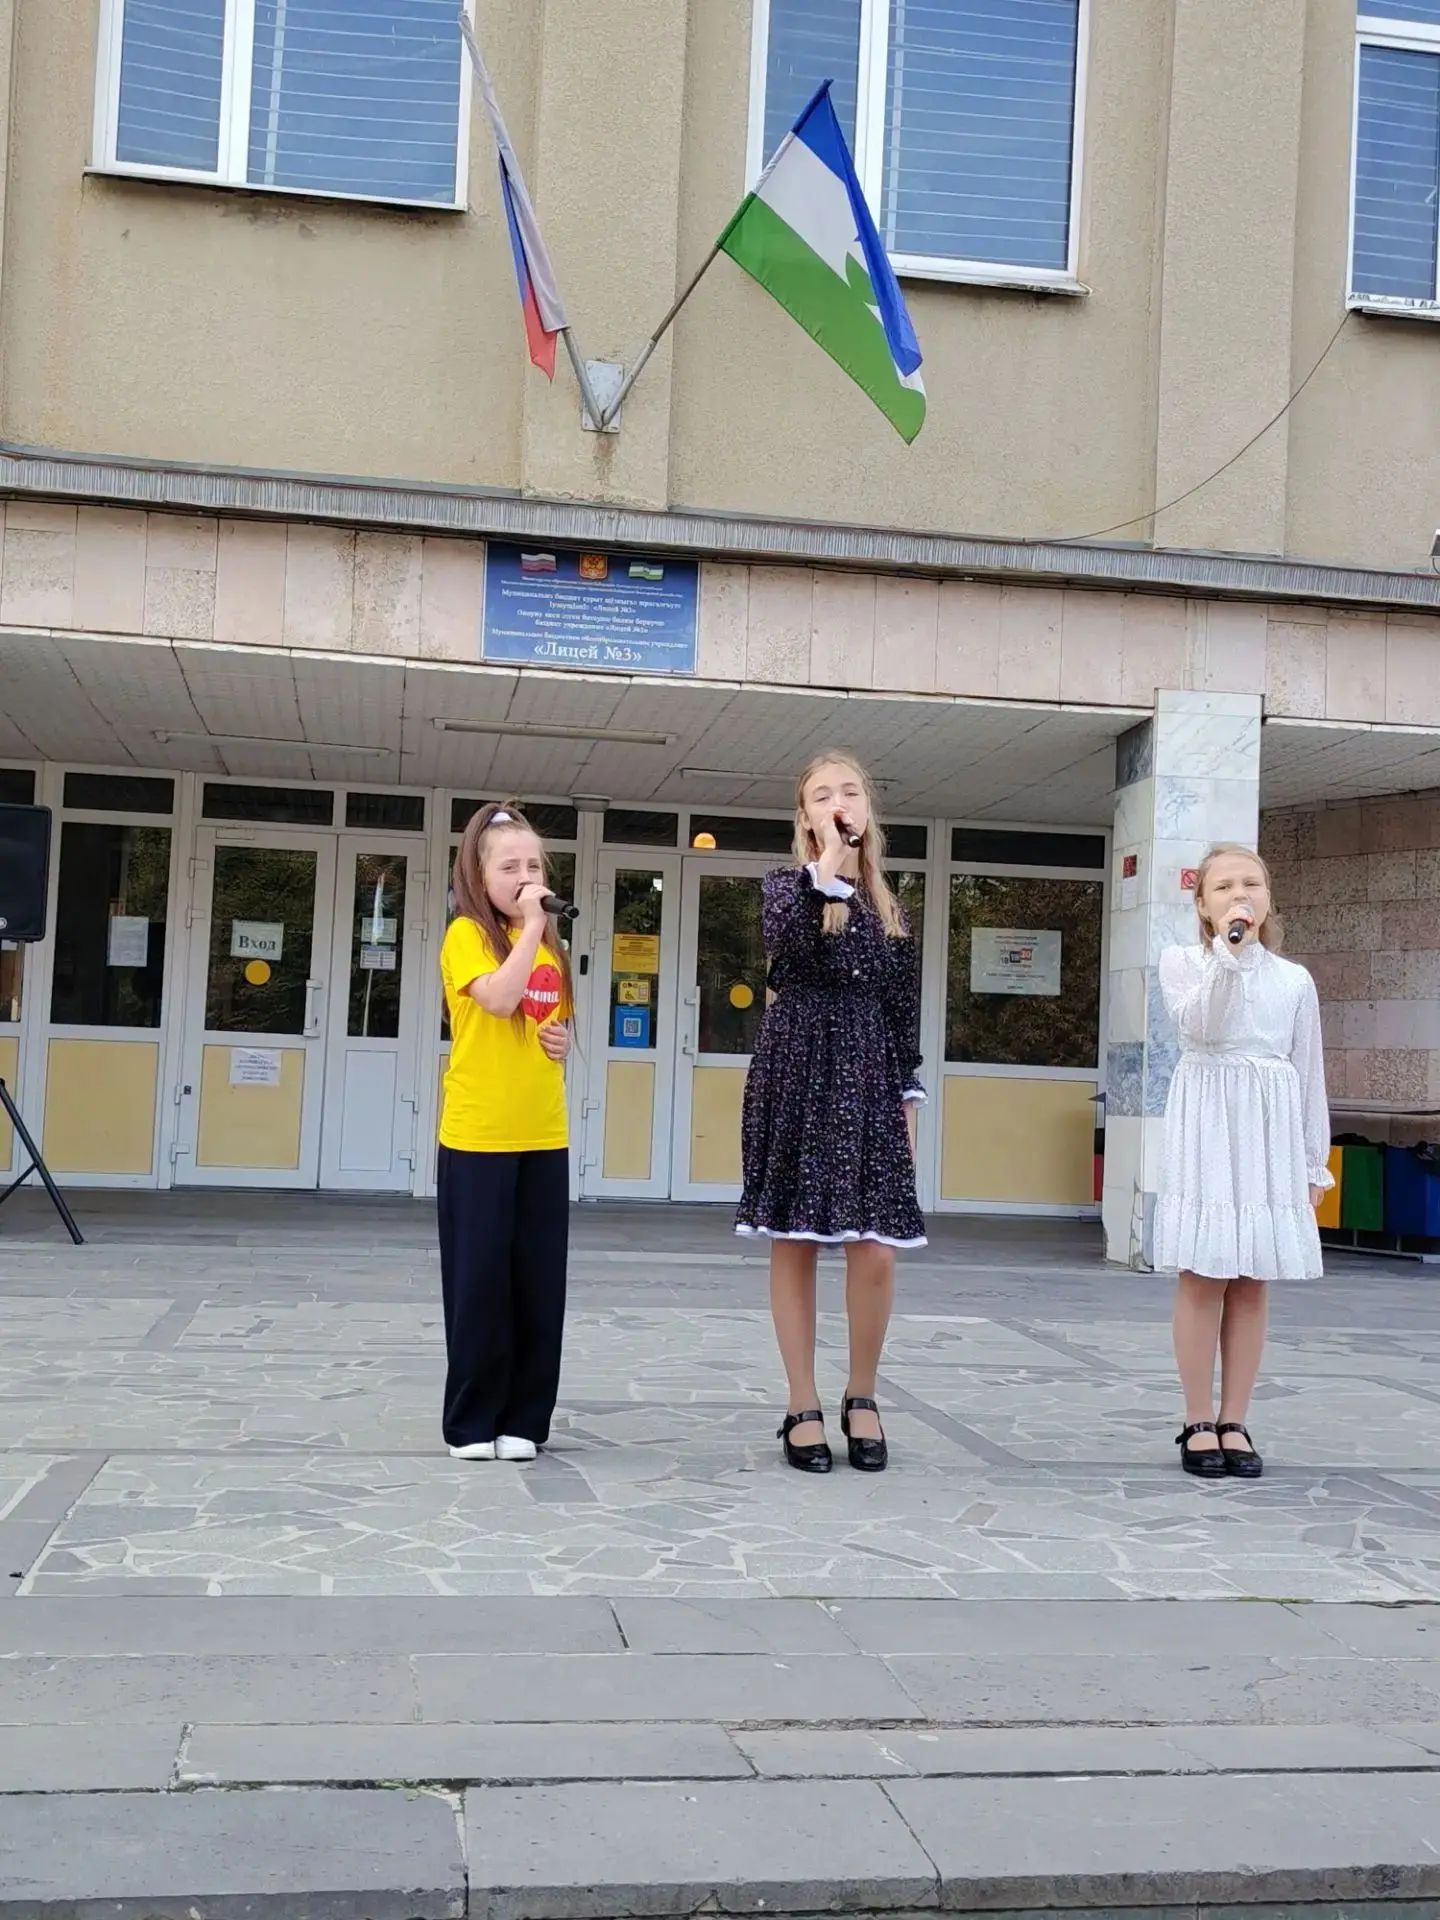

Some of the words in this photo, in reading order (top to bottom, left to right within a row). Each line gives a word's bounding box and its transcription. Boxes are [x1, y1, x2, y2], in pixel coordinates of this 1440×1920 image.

[534, 641, 598, 659] «Лицей
[604, 646, 642, 662] №3»
[239, 935, 276, 952] Вход
